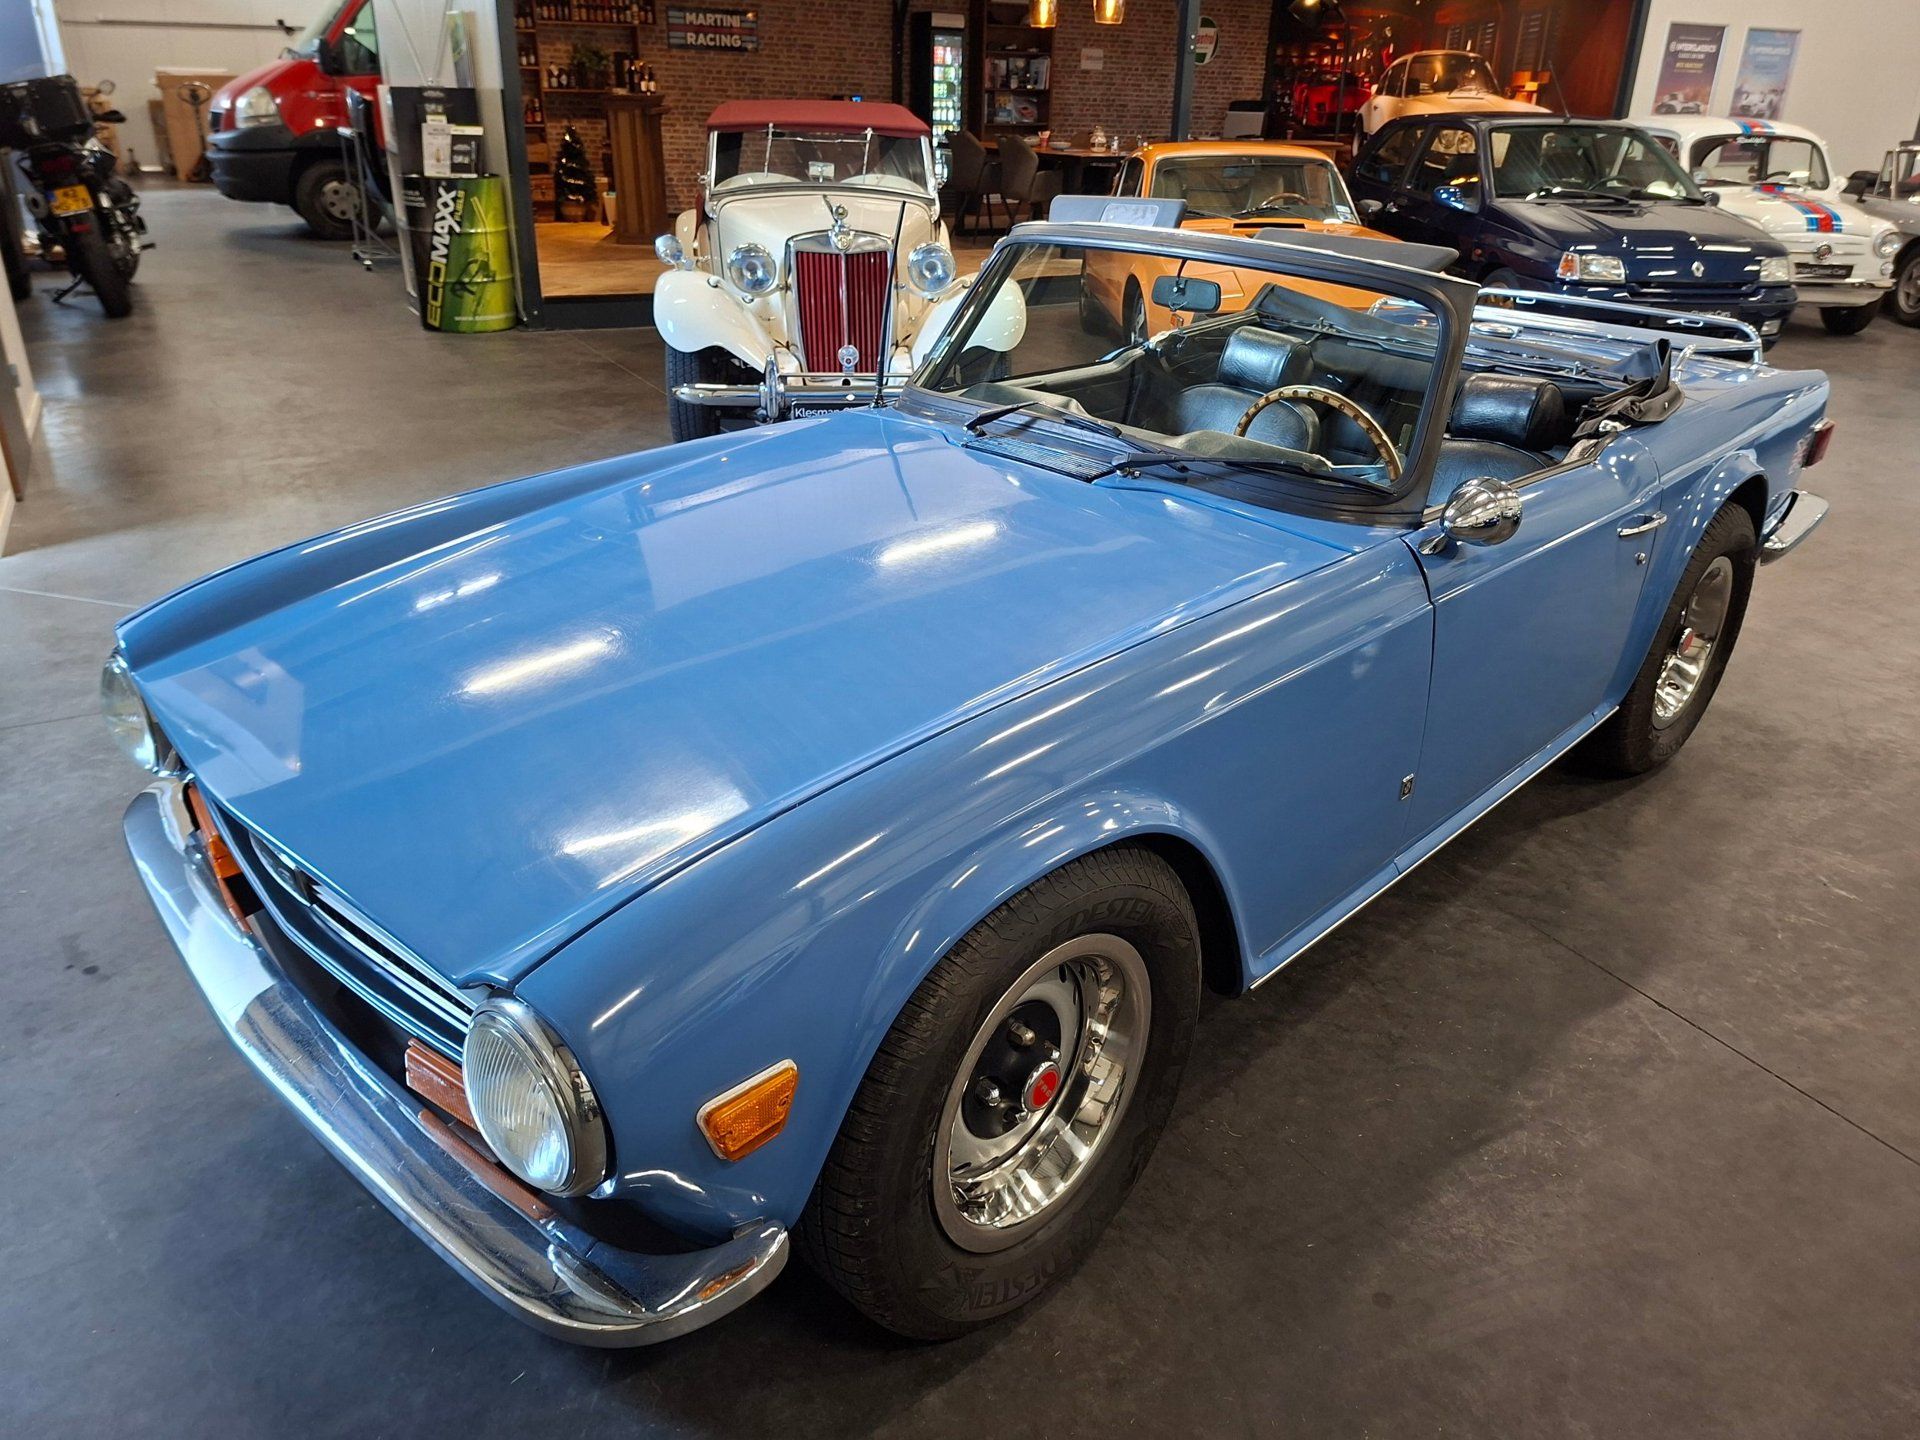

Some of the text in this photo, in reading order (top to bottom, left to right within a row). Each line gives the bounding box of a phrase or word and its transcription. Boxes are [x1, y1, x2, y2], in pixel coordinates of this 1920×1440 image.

[686, 12, 741, 28] MARTINI
[686, 32, 742, 48] RACING
[1196, 33, 1216, 45] astrol
